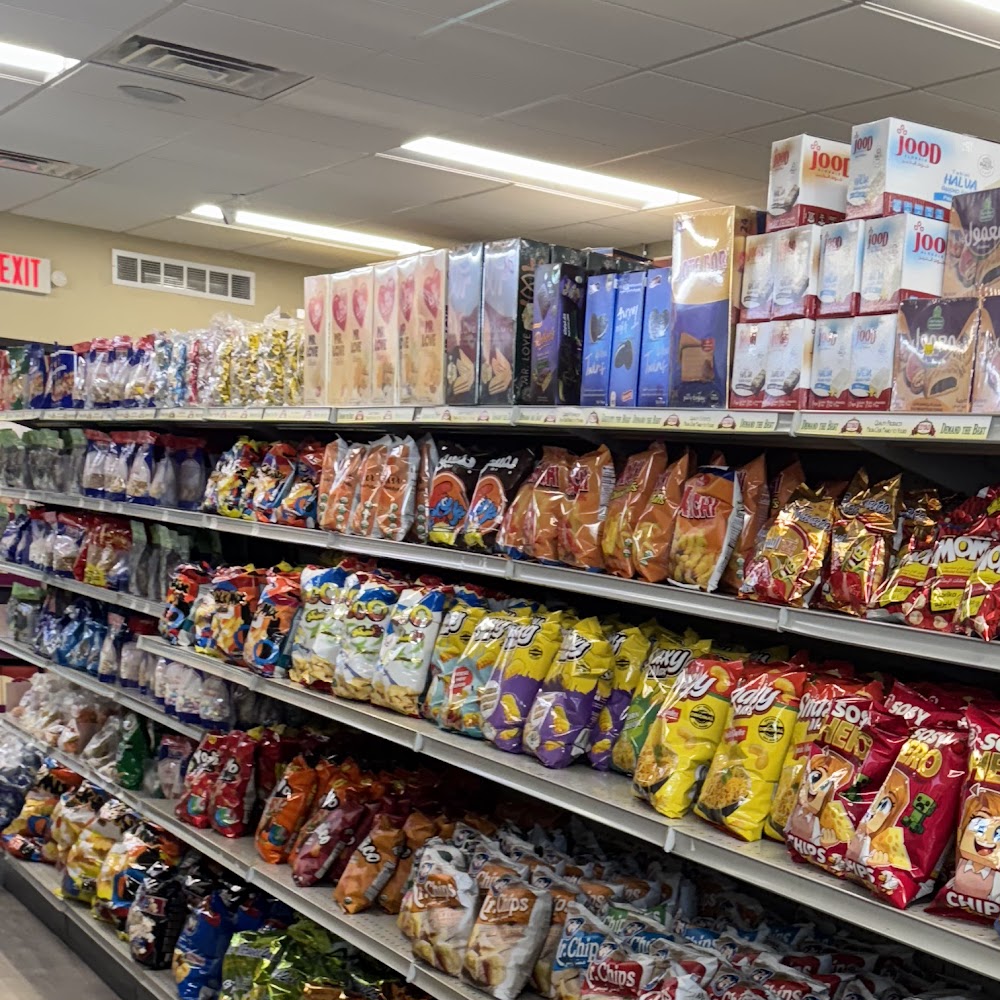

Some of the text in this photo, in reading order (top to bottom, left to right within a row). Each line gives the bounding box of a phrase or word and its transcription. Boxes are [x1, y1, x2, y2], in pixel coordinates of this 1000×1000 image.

[852, 135, 873, 154] JOOD
[896, 135, 941, 165] JOOD
[944, 174, 977, 190] HALVA
[913, 234, 945, 253] JOO
[0, 254, 41, 288] EXIT
[940, 423, 960, 435] DEMAND
[973, 425, 987, 436] BEST
[601, 962, 636, 987] Chips
